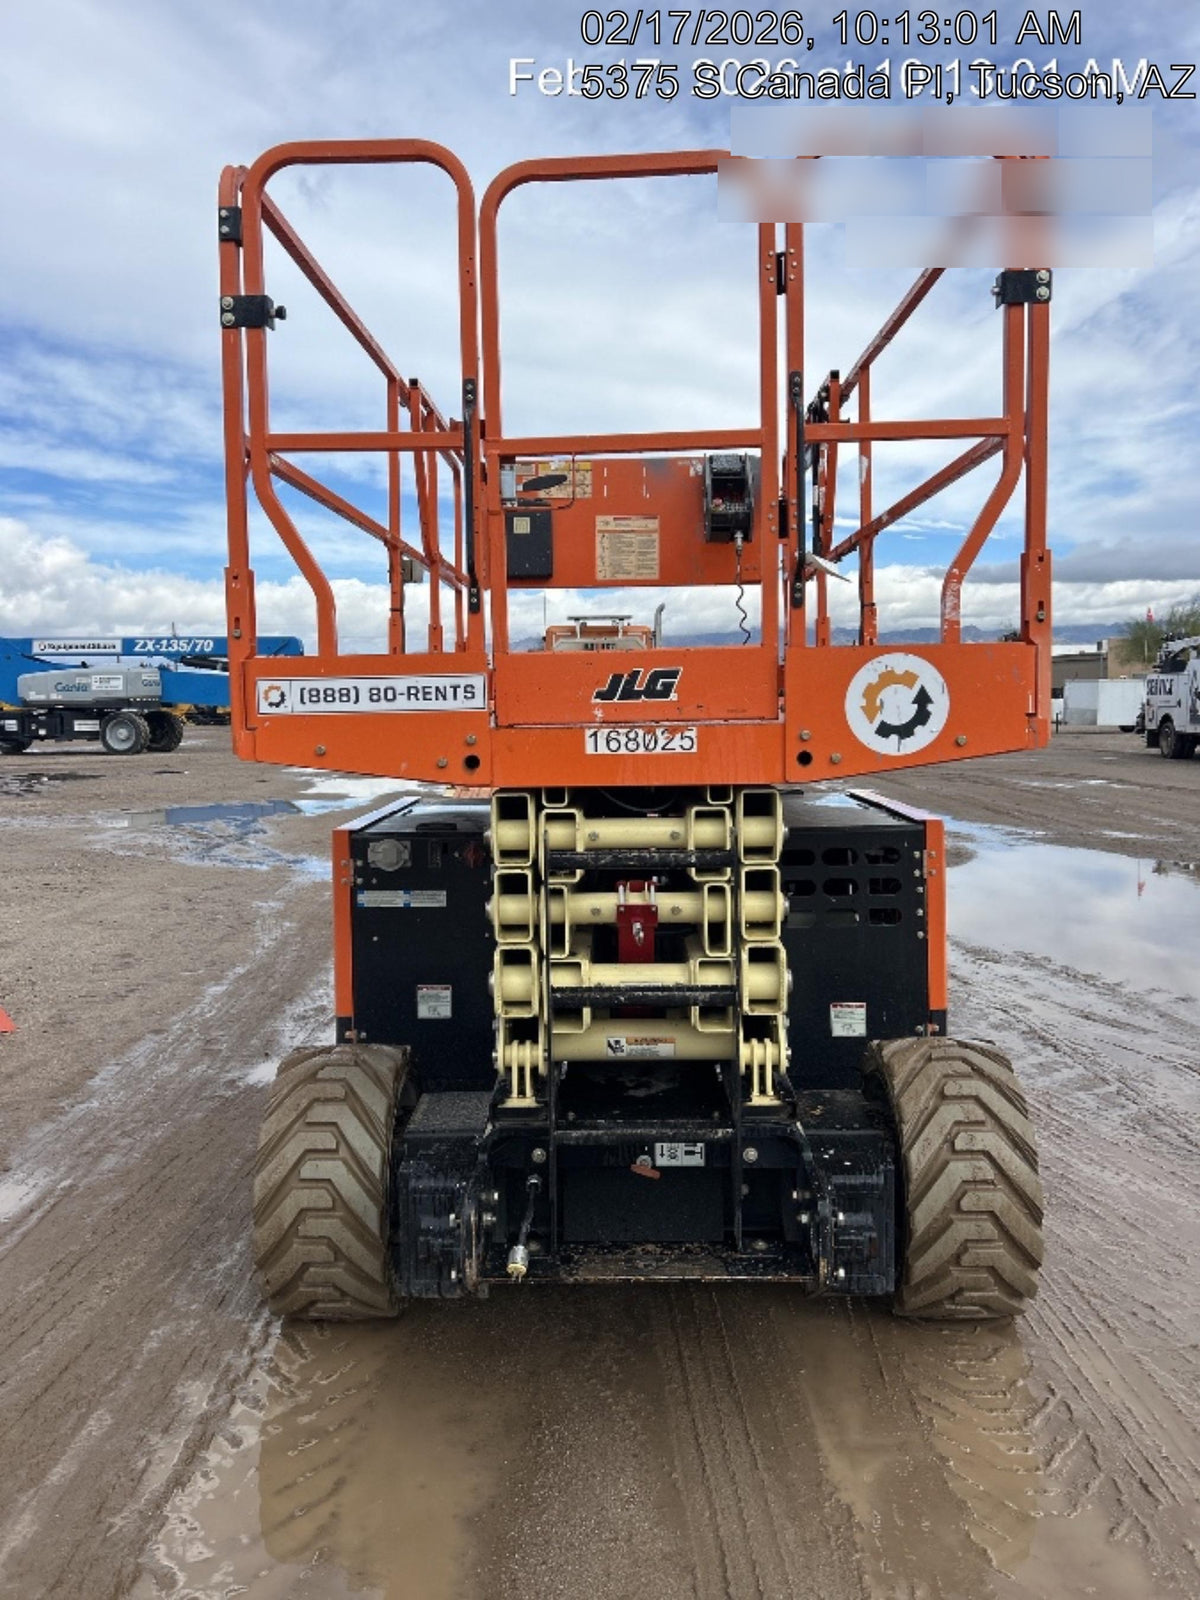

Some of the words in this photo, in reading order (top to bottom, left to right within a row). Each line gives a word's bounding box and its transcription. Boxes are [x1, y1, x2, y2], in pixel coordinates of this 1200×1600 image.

[133, 639, 214, 653] ZX-135/70
[299, 686, 360, 704] (888)
[368, 684, 476, 703] 80-RENTS
[591, 666, 683, 703] JLG
[588, 727, 695, 753] 168025
